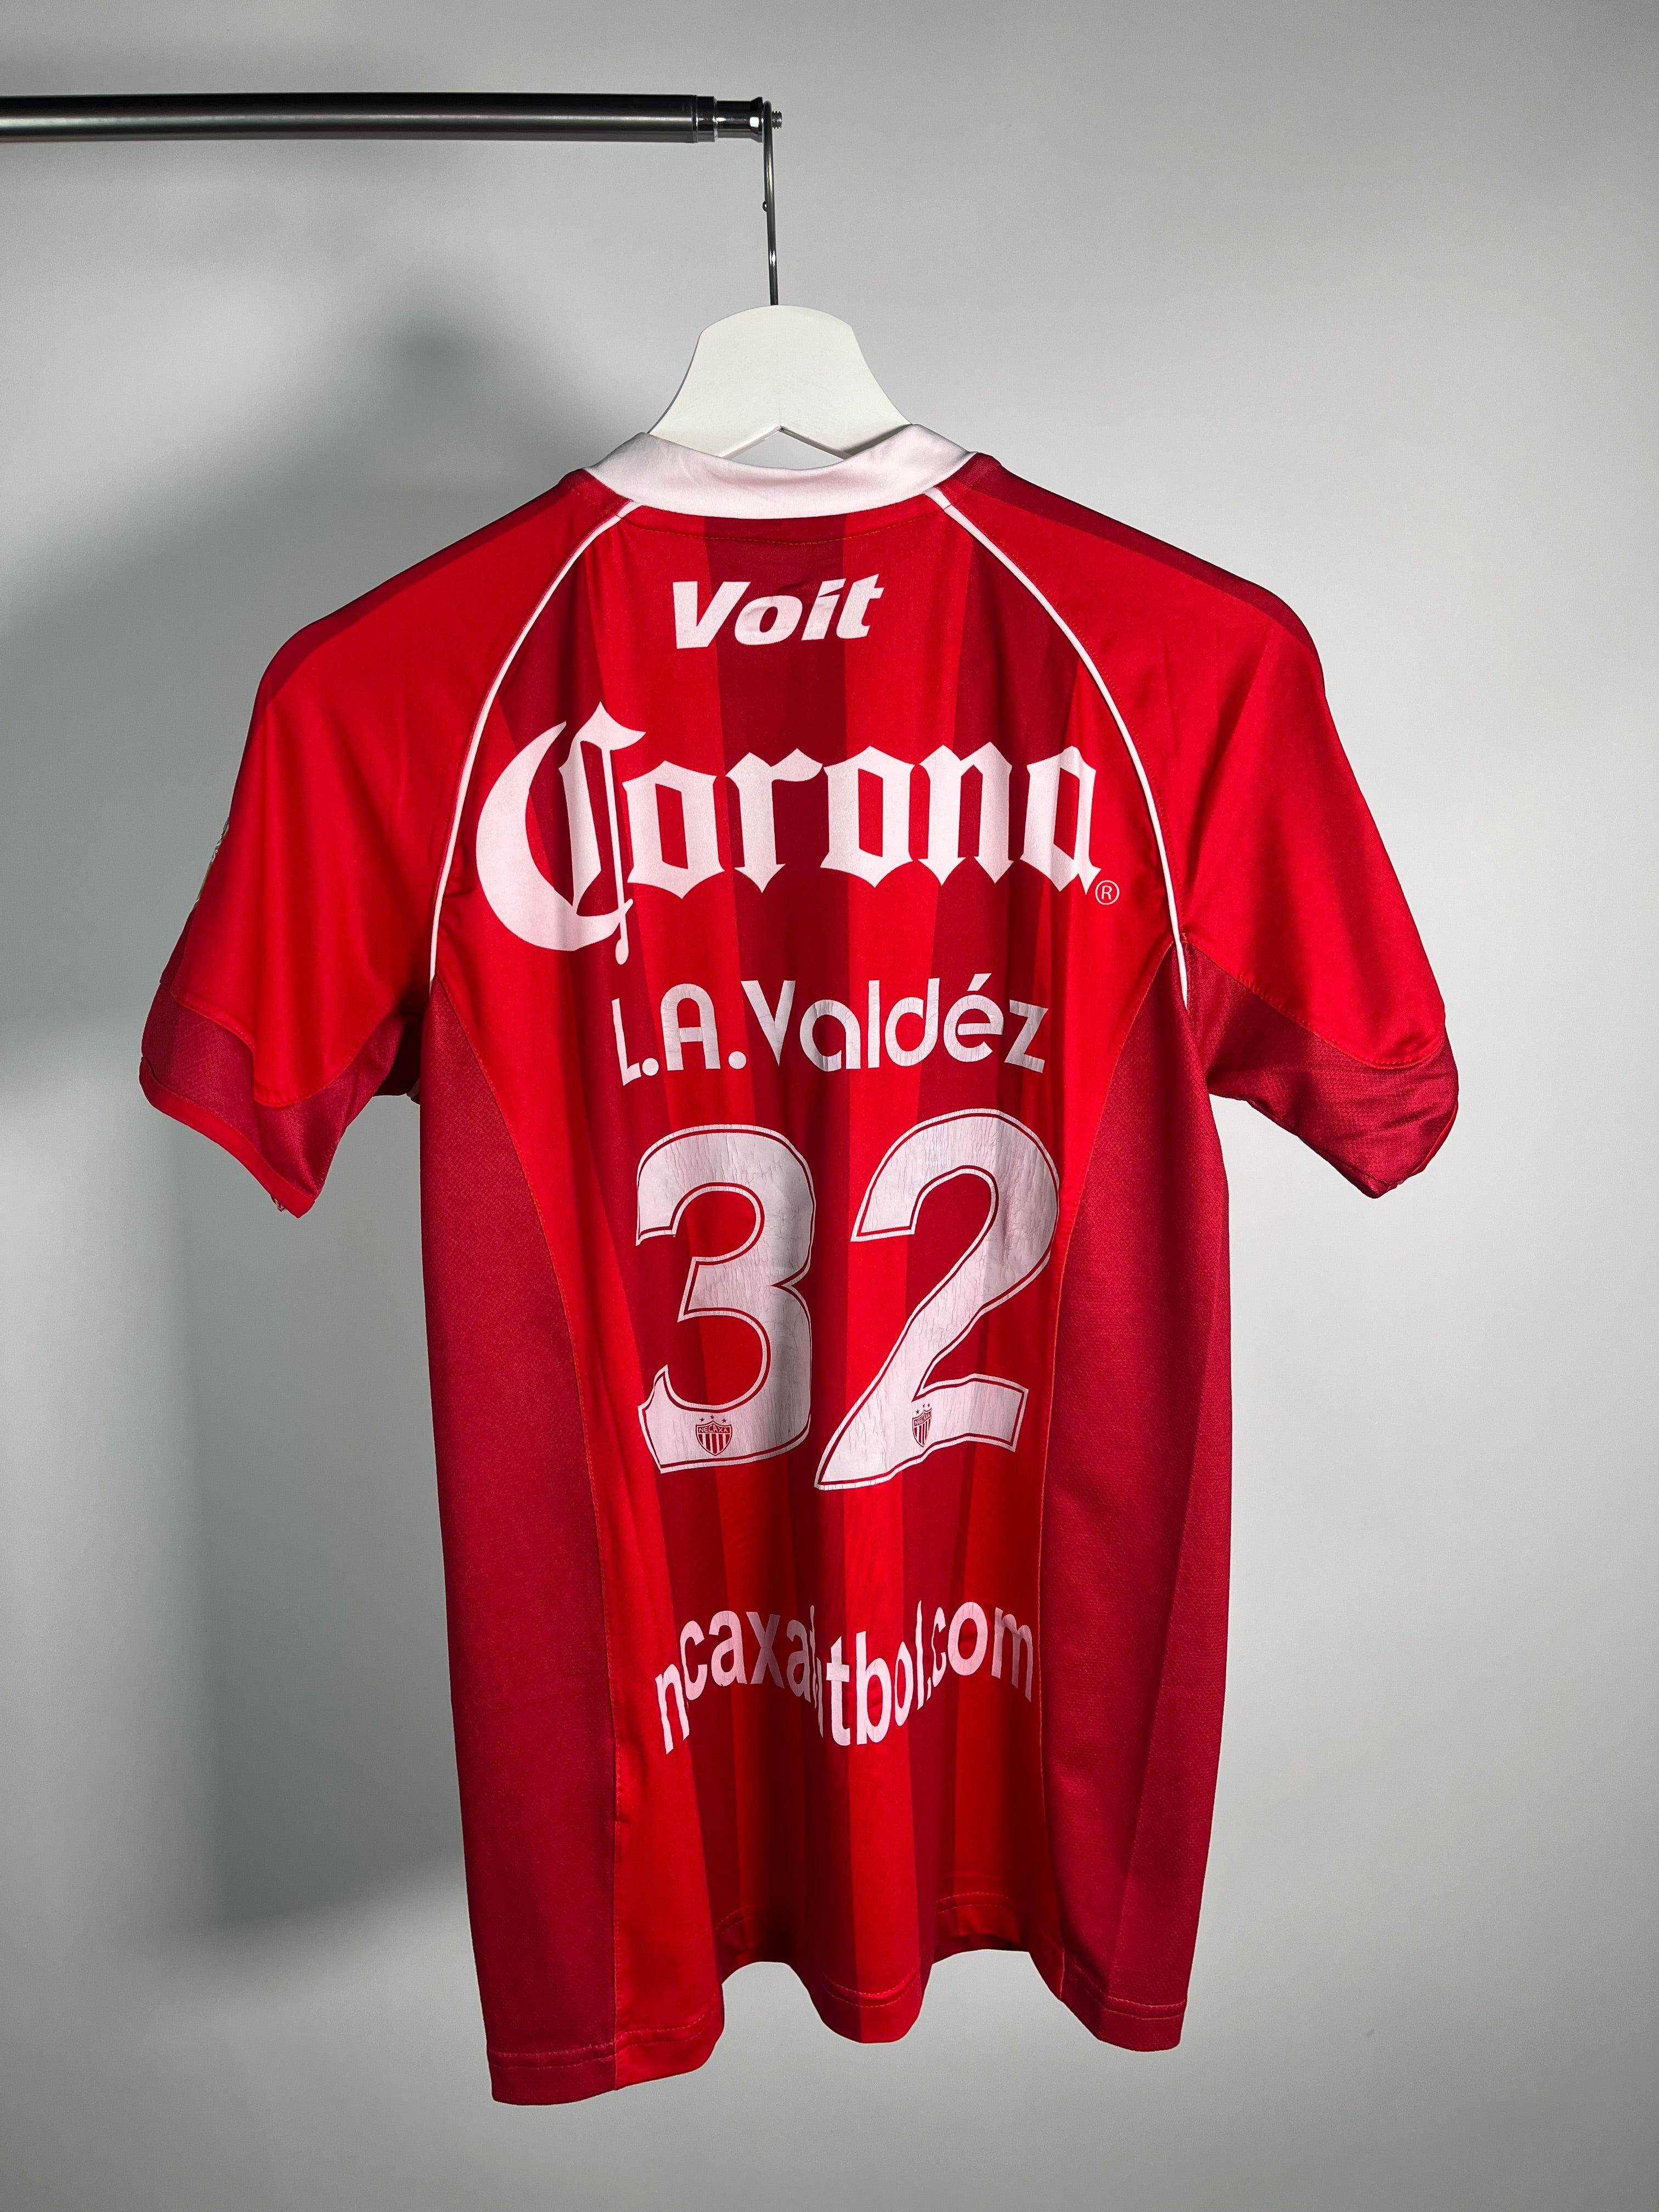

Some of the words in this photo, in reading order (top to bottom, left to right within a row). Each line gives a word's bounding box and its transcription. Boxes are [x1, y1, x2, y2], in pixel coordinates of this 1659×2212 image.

[673, 574, 884, 649] Voit
[476, 701, 1102, 965] Corona
[636, 1108, 1059, 1491] 32
[698, 1423, 729, 1434] NECAXA
